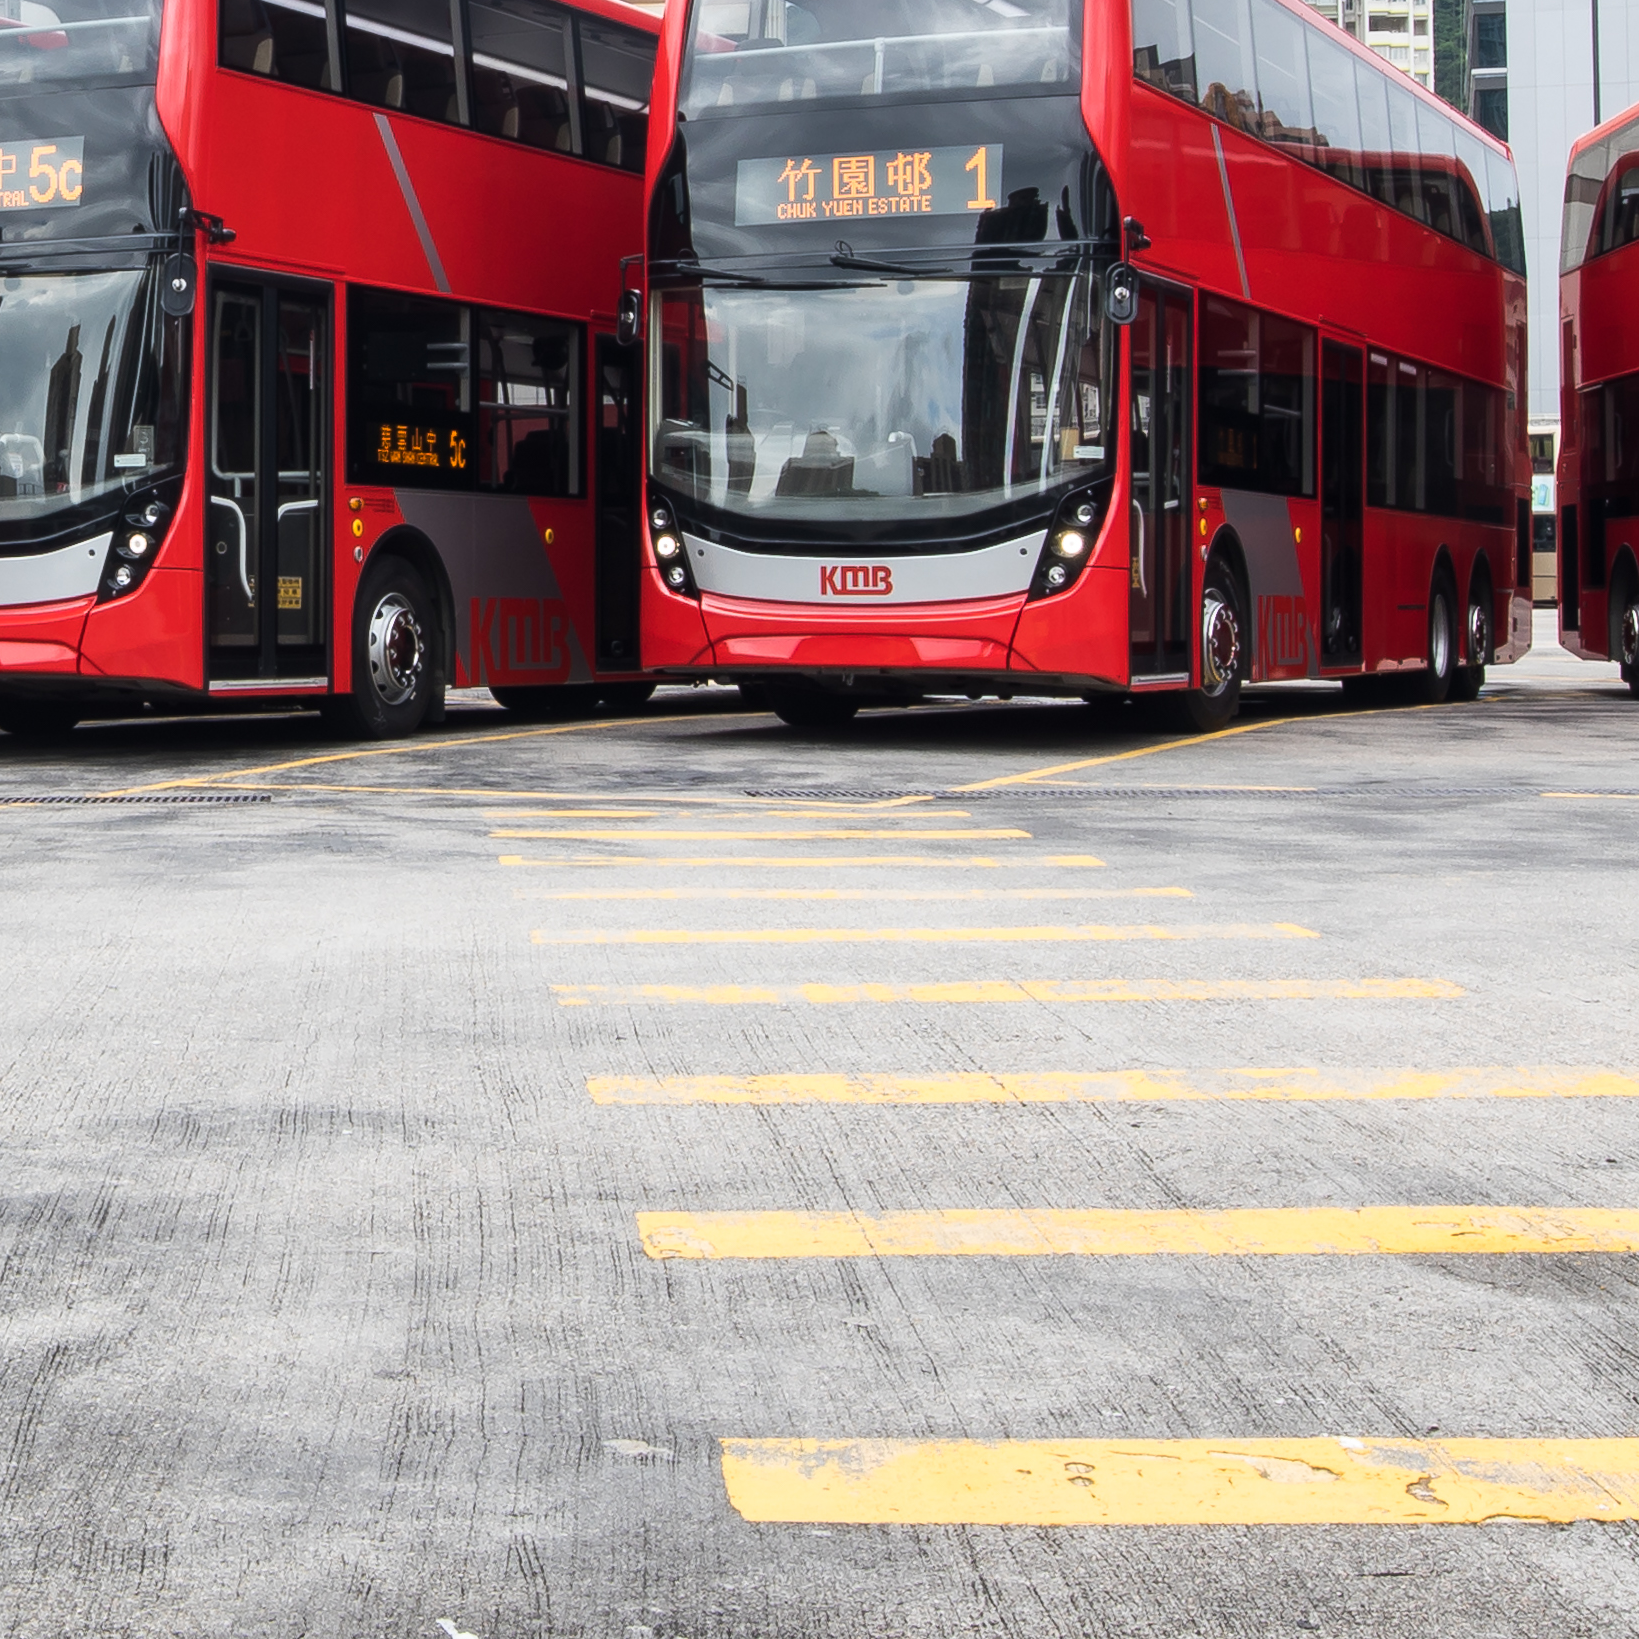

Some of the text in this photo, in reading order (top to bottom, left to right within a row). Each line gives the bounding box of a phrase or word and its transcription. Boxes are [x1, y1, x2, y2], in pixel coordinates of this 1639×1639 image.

[777, 152, 932, 202] 竹園邨
[965, 146, 997, 209] 1
[777, 195, 932, 220] CHUK YUEN ESTATE
[820, 565, 893, 596] KMB
[470, 598, 571, 687] KMB
[1257, 594, 1311, 679] KMB
